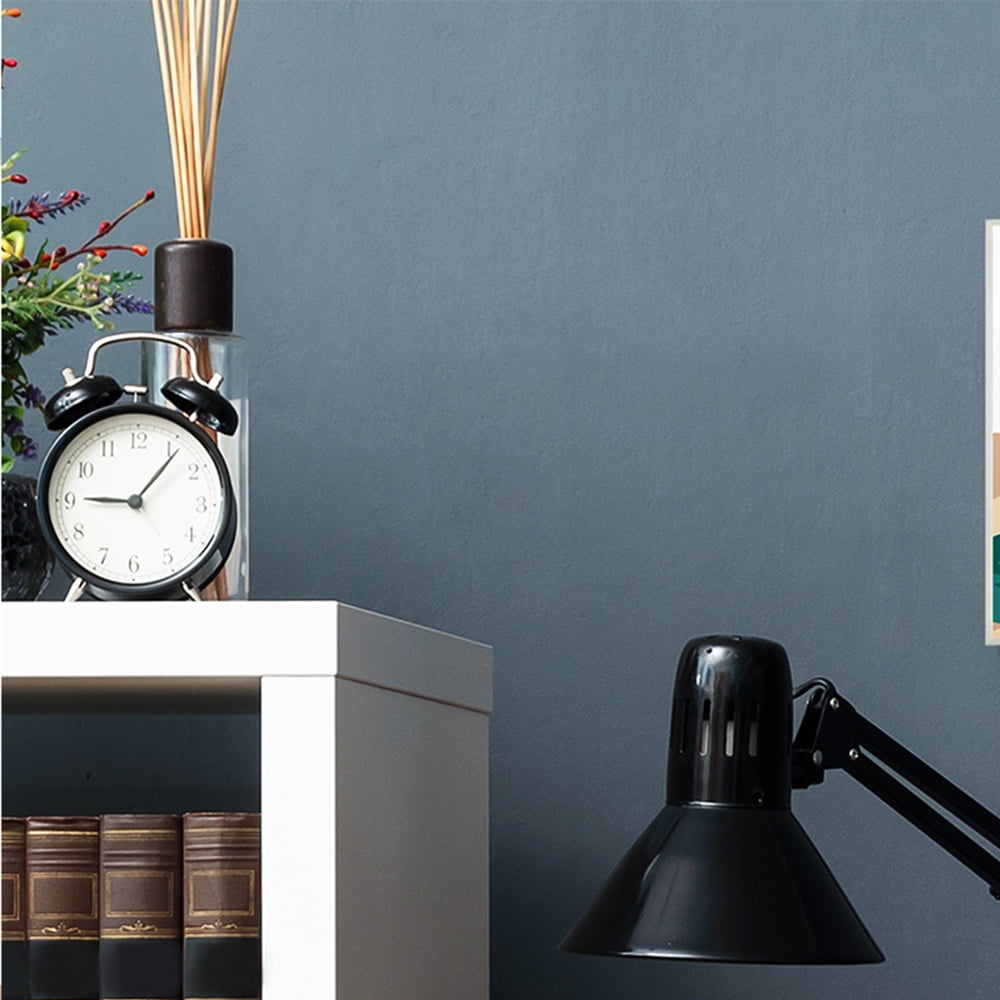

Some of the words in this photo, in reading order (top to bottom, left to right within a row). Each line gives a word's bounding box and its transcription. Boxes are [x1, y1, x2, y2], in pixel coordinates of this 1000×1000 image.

[101, 440, 114, 457] 11
[130, 432, 148, 449] 12
[79, 462, 94, 478] 10
[188, 464, 199, 480] 2
[65, 492, 76, 509] 9
[196, 496, 207, 513] 3
[73, 524, 84, 540] 8
[185, 527, 196, 542] 4
[98, 548, 109, 565] 7
[128, 555, 139, 572] 6
[163, 548, 173, 564] 5
